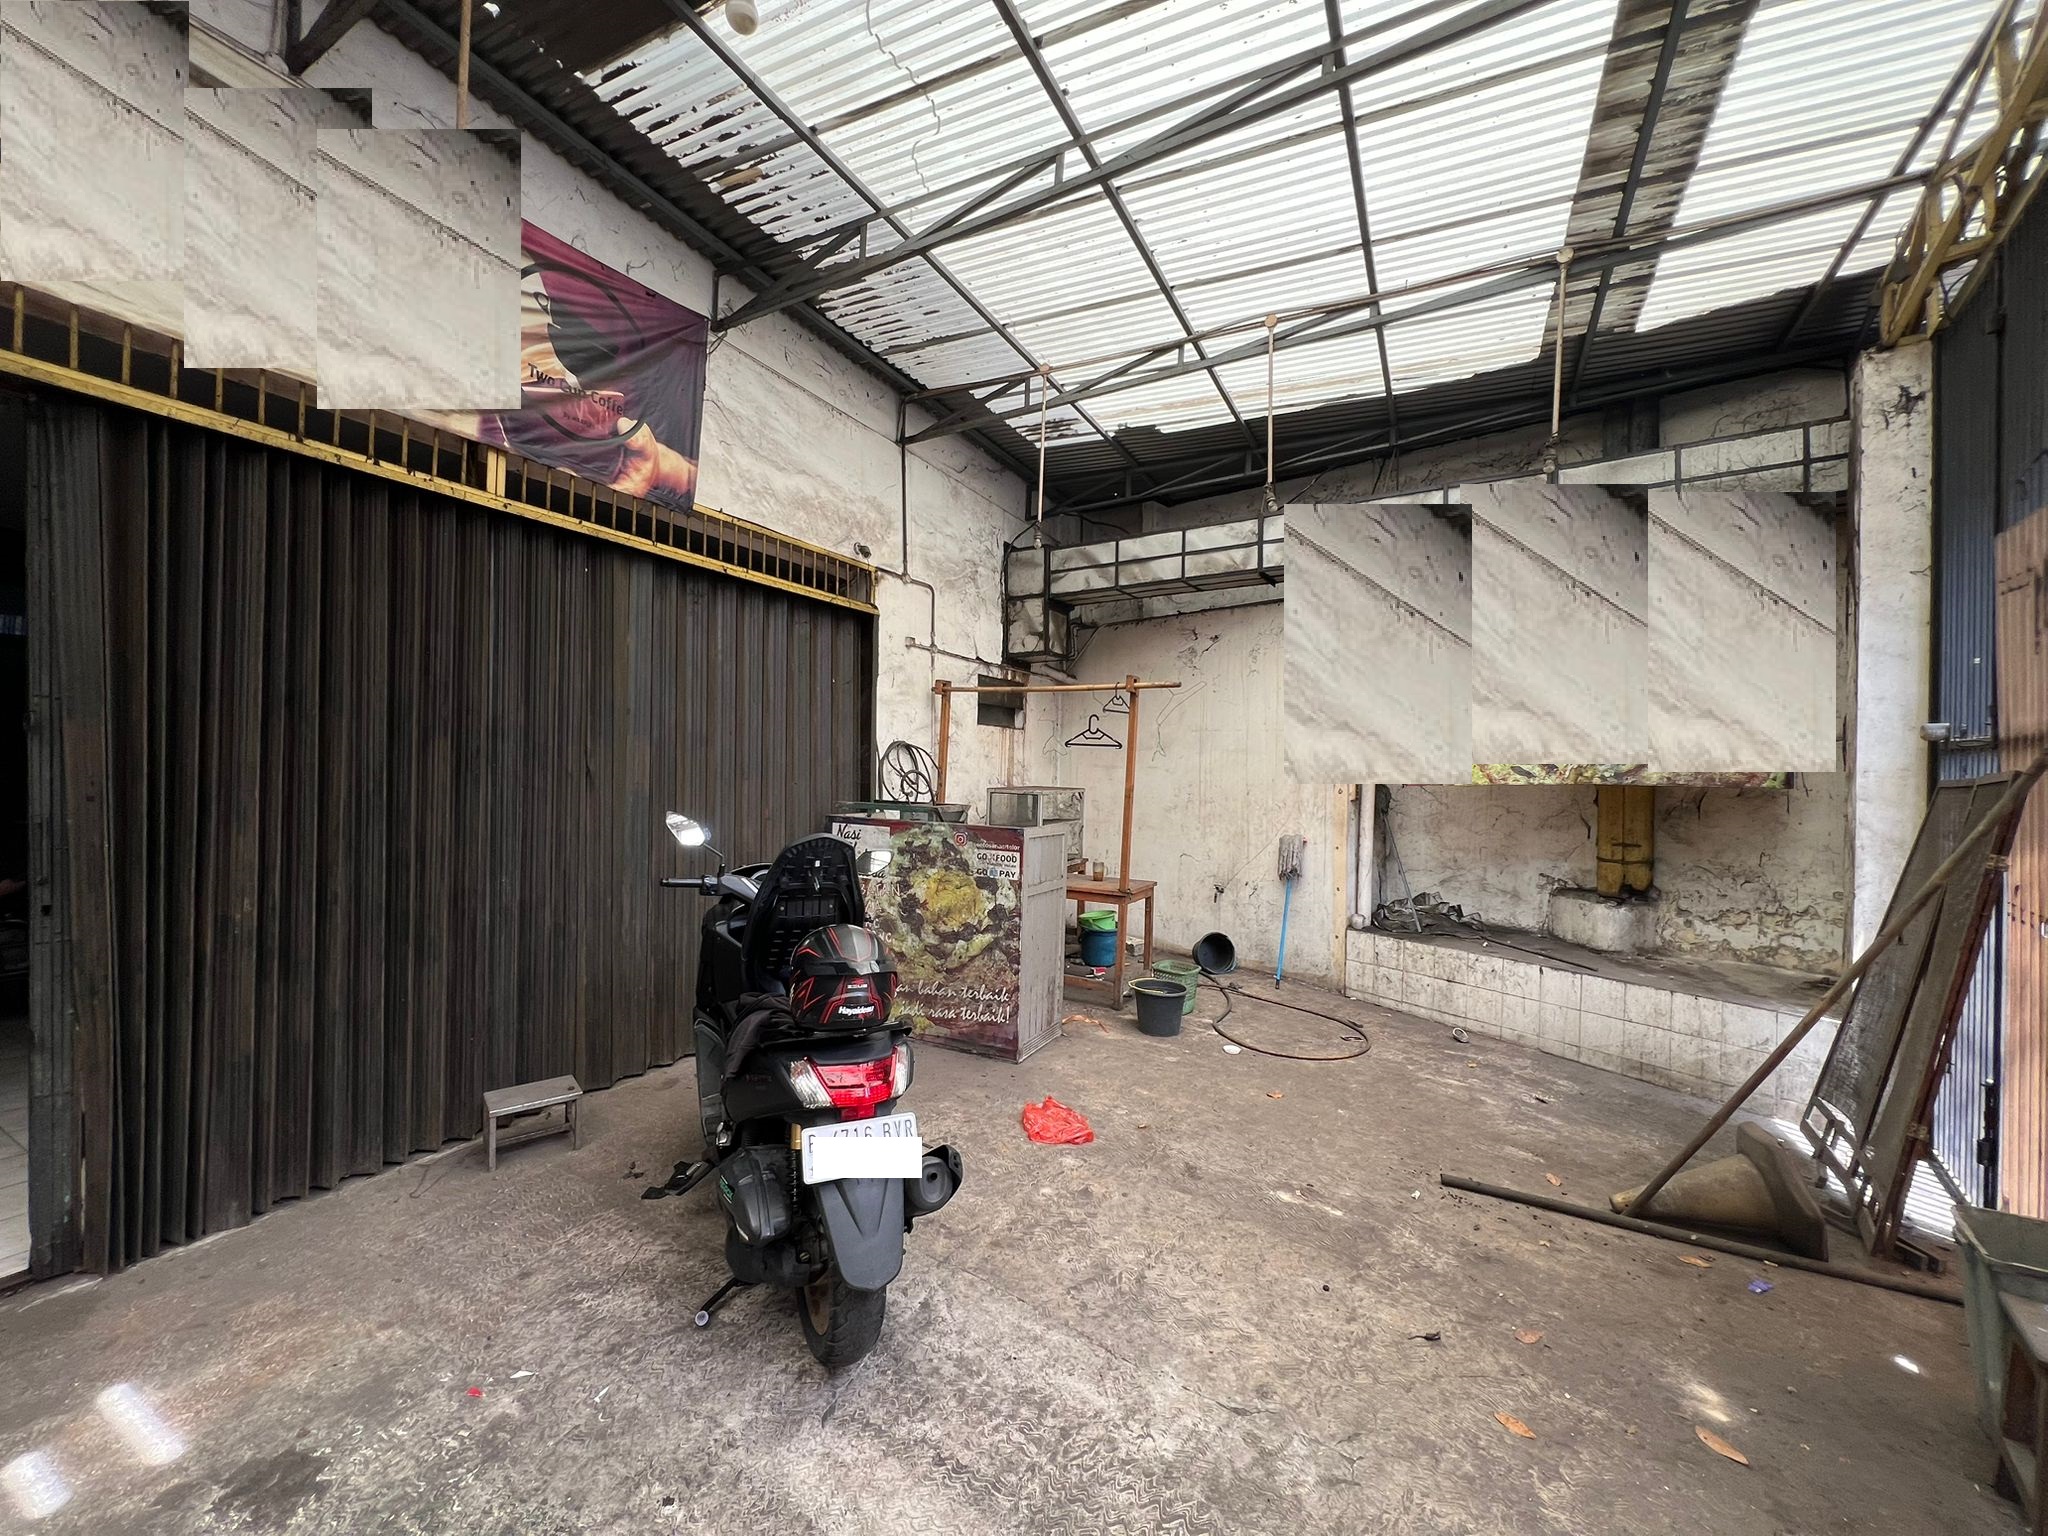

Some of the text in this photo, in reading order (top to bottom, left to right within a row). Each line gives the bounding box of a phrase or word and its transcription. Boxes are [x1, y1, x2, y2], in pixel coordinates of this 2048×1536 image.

[528, 362, 555, 385] Two
[561, 378, 587, 398] Cup
[836, 823, 862, 840] Nasi
[976, 852, 1018, 863] GO FOOD
[999, 870, 1017, 879] PAY
[918, 980, 957, 998] bahan
[959, 984, 1010, 1003] terbaik
[929, 1008, 957, 1019] rasa
[960, 1004, 1011, 1024] terbaik!
